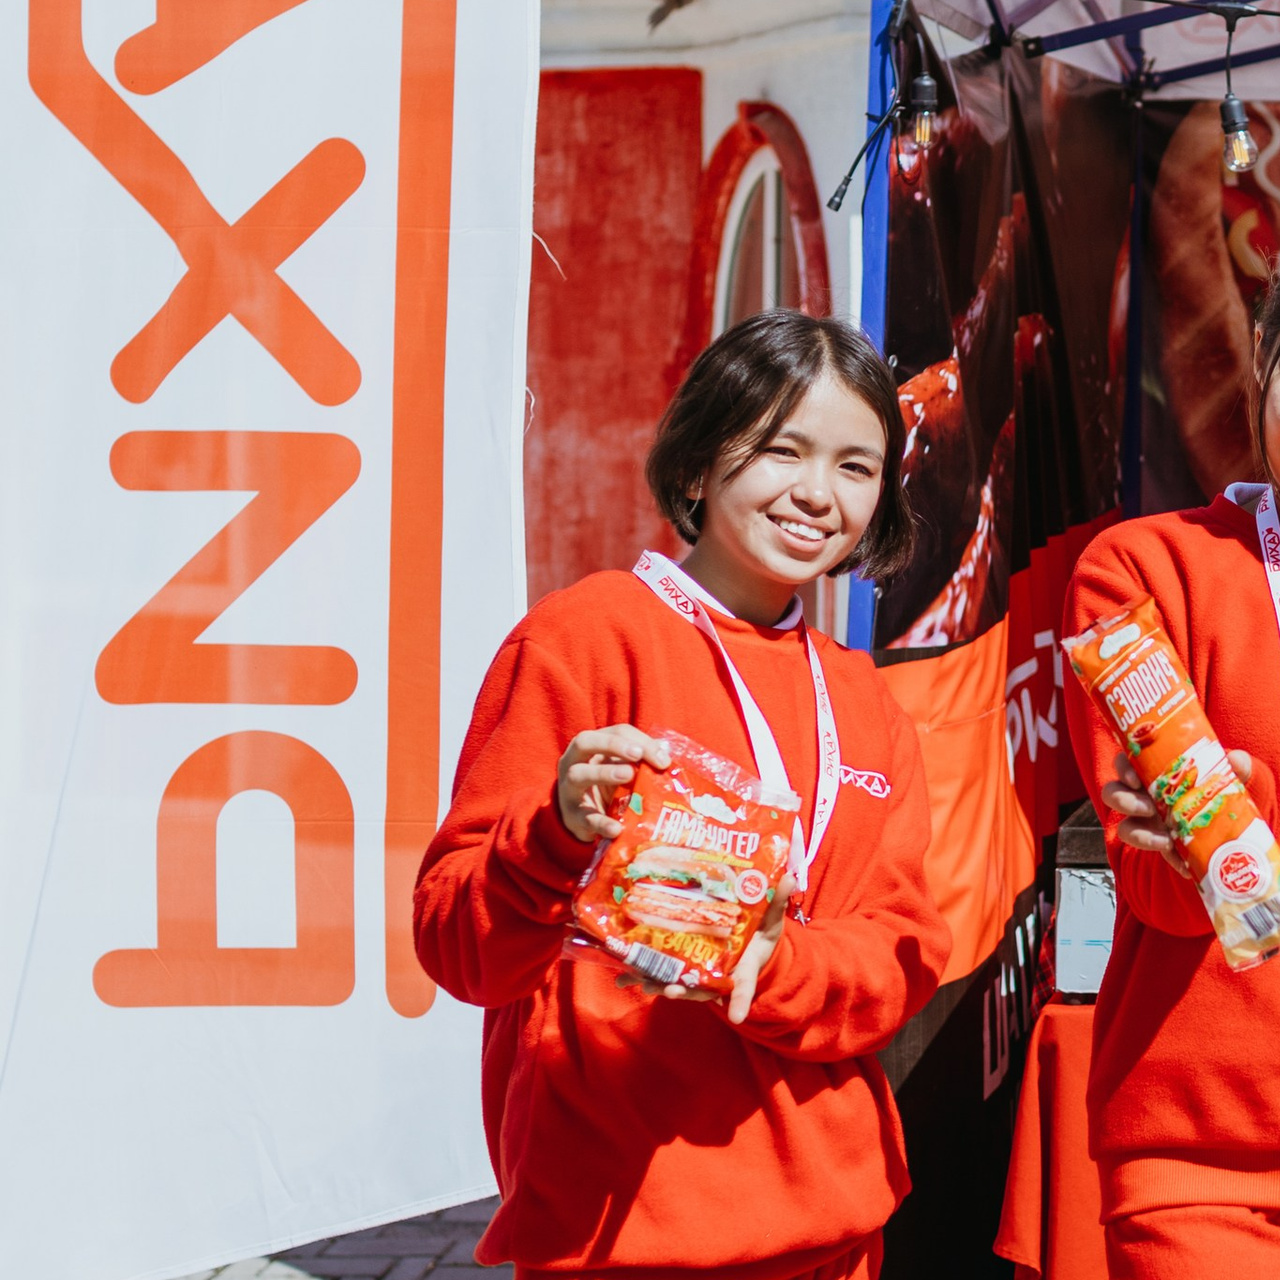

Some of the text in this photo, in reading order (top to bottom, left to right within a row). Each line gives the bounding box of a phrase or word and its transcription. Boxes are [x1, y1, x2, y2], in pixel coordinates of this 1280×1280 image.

[657, 575, 695, 614] РИХА
[840, 767, 884, 798] ИХА
[651, 806, 760, 859] ГАМБУРГЕР
